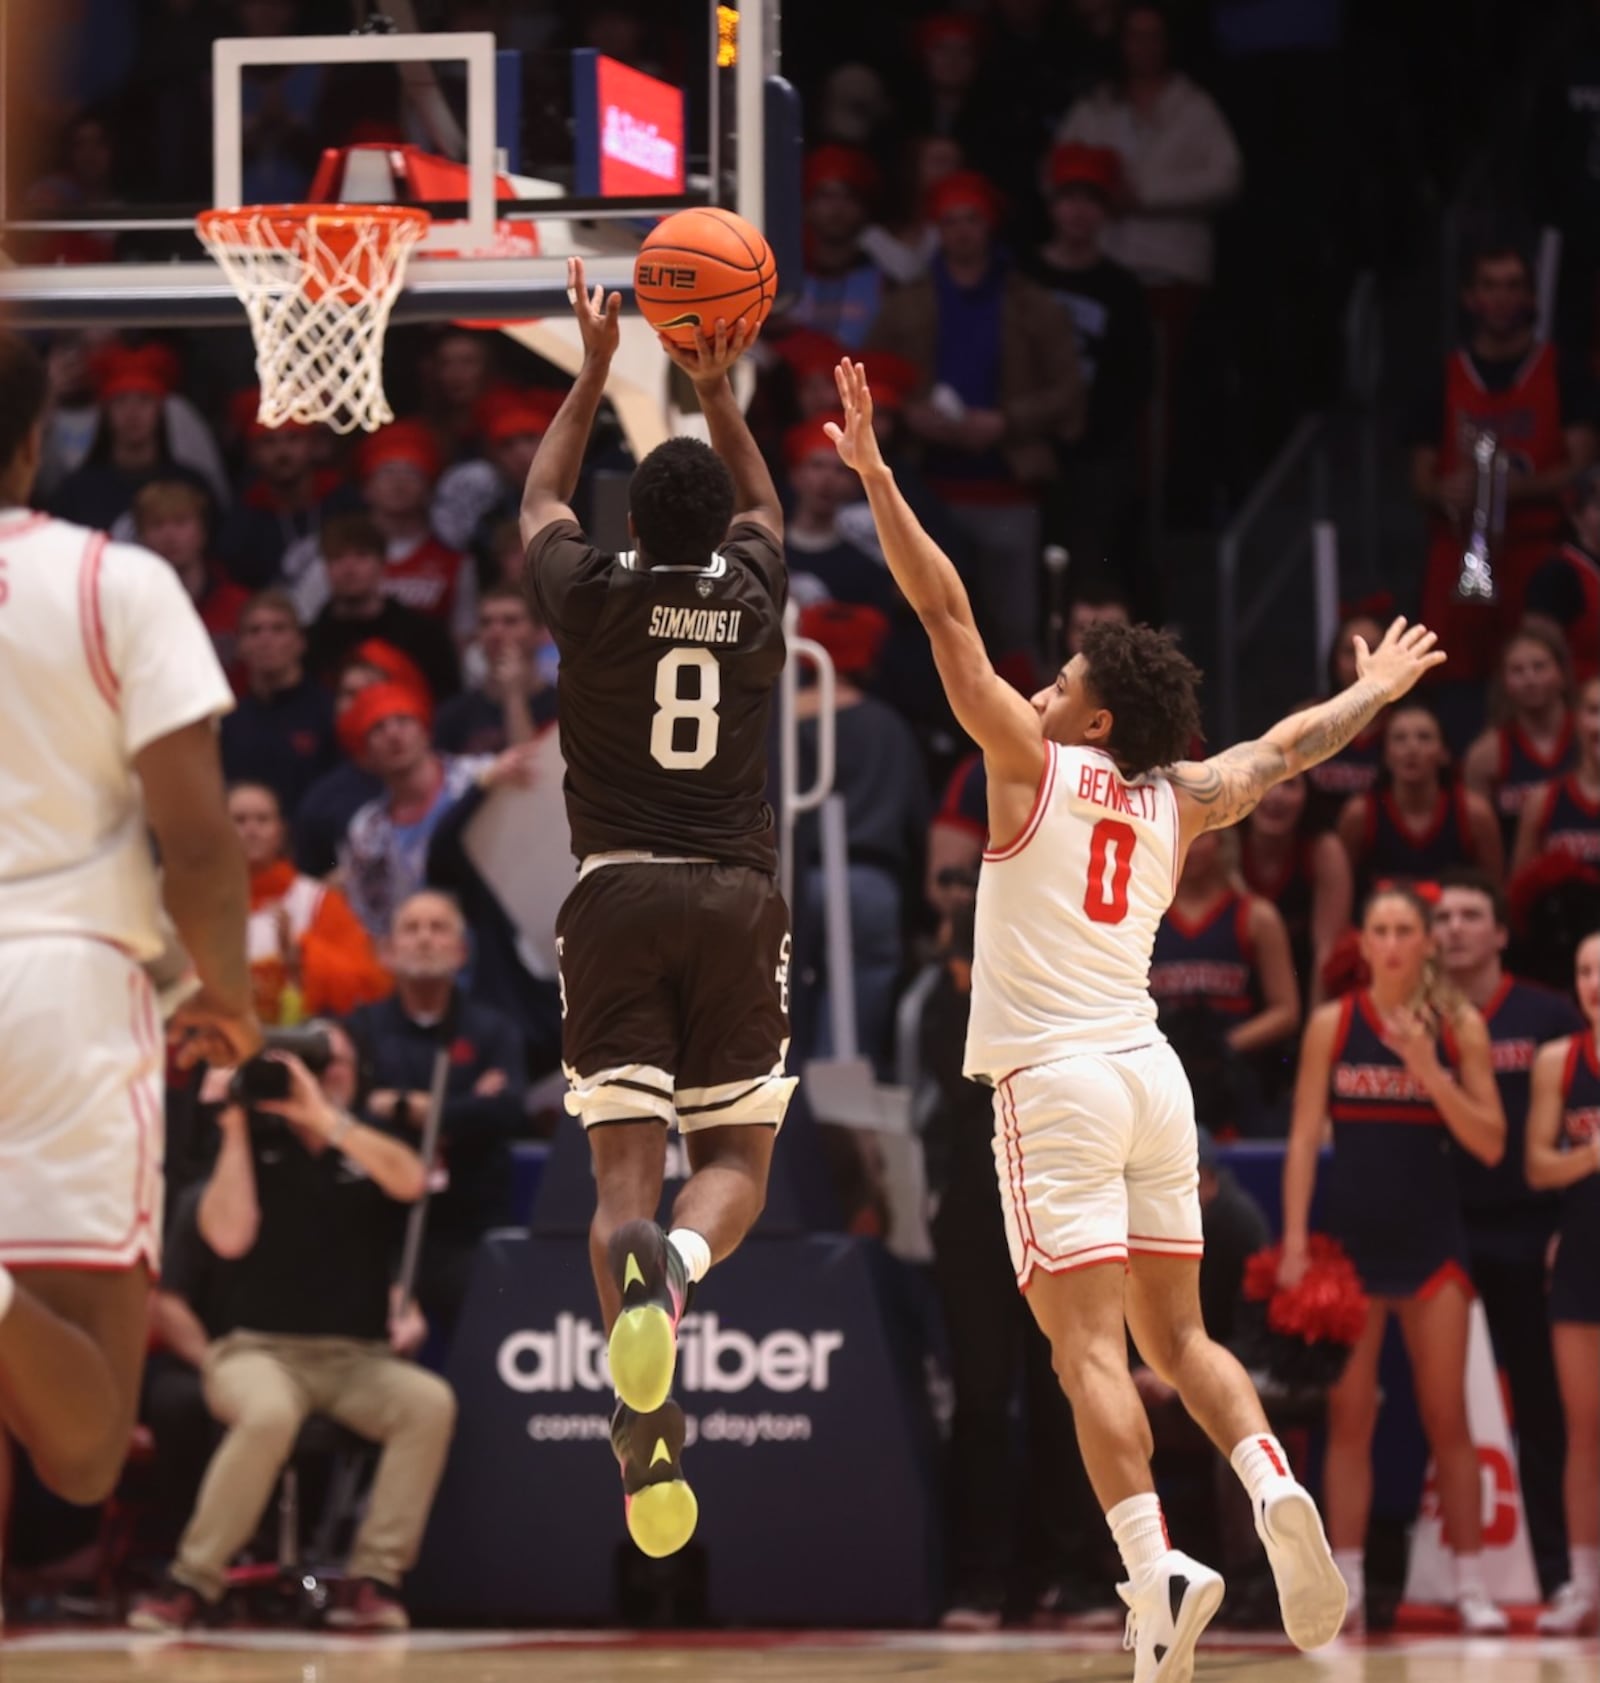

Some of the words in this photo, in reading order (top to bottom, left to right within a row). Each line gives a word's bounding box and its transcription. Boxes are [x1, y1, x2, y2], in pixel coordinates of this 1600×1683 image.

[638, 265, 697, 290] ELITE
[649, 605, 727, 643] SIMMONS
[650, 647, 721, 770] 8
[1077, 763, 1157, 822] BENNETT
[1083, 817, 1137, 925] 0
[1334, 1062, 1434, 1101] DAYT
[496, 1311, 845, 1392] altiber
[526, 1413, 699, 1448] conng
[700, 1410, 812, 1446] dayton
